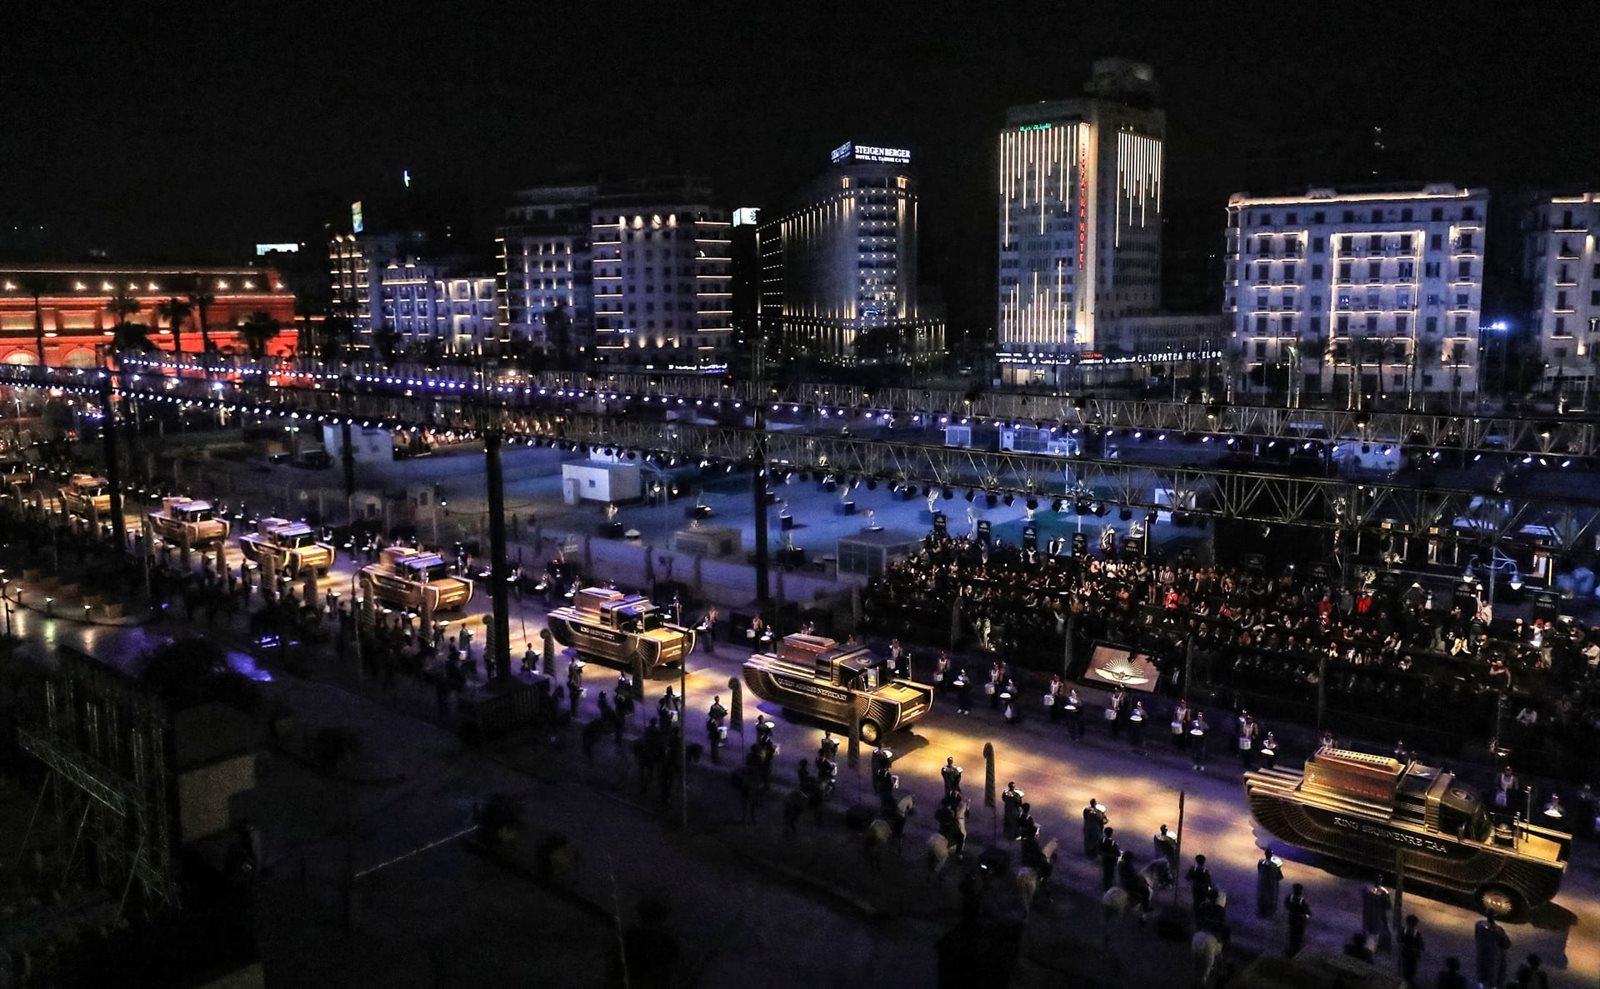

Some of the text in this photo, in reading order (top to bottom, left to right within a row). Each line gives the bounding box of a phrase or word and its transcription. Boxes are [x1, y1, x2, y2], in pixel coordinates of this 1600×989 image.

[1137, 352, 1183, 363] CLEOPATRA
[1333, 816, 1359, 830] KING
[1425, 840, 1447, 853] TAA
